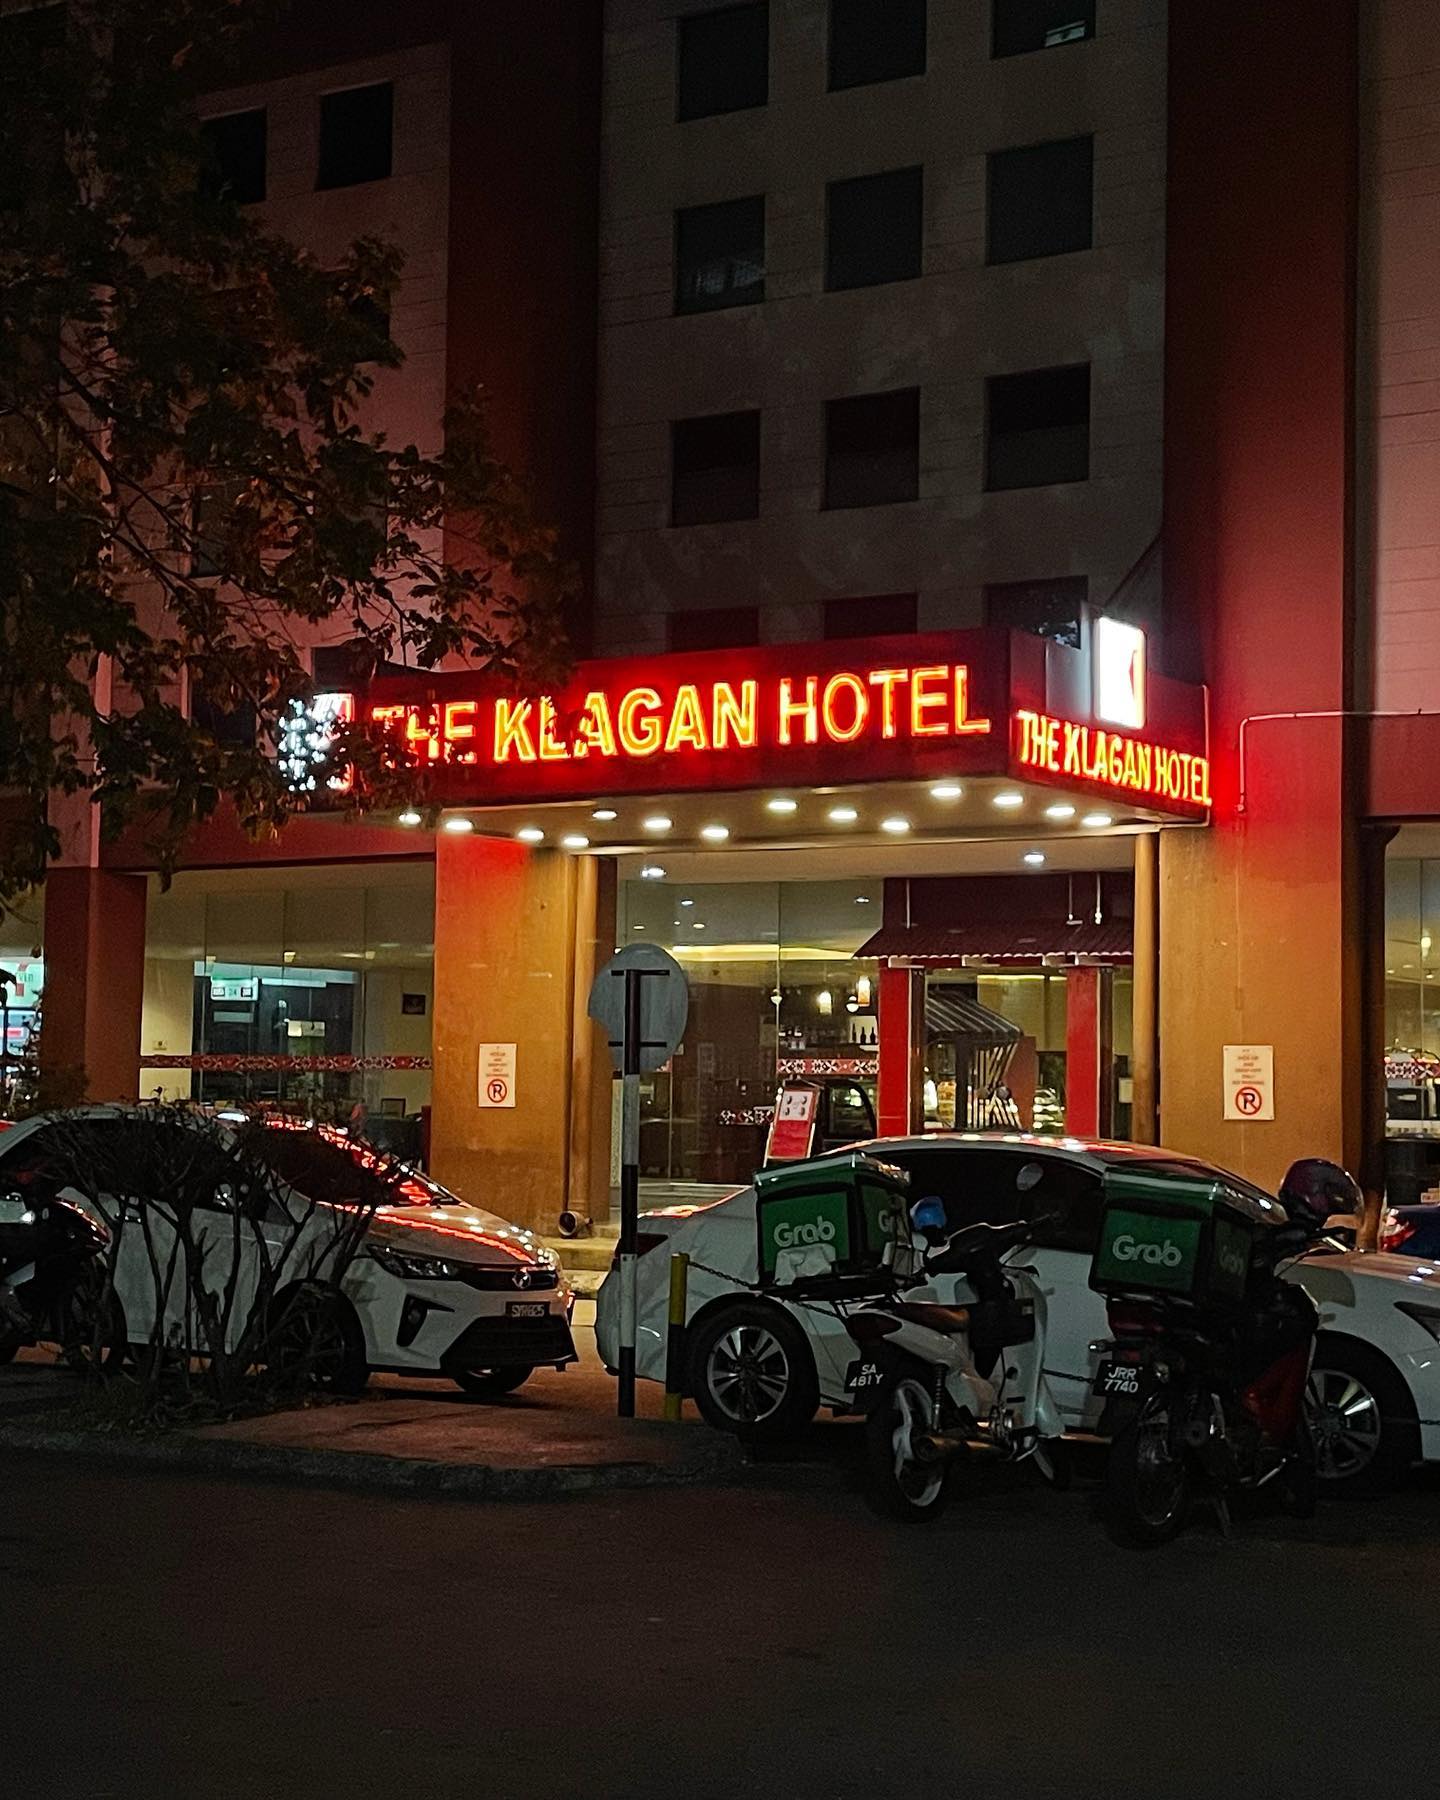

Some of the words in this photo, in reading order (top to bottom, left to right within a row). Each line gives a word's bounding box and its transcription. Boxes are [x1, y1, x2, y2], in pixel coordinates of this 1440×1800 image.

[494, 680, 757, 762] KLAGAN
[778, 665, 990, 744] HOTEL
[1016, 710, 1060, 771] THE
[1064, 721, 1150, 791] KLAGAN
[1155, 746, 1212, 806] HOTEL
[773, 1215, 836, 1247] Grab
[1112, 1235, 1183, 1267] Grab
[849, 1374, 884, 1387] 481Y
[861, 1363, 877, 1376] SA
[1108, 1366, 1137, 1380] JRR
[1103, 1378, 1139, 1393] 7740
